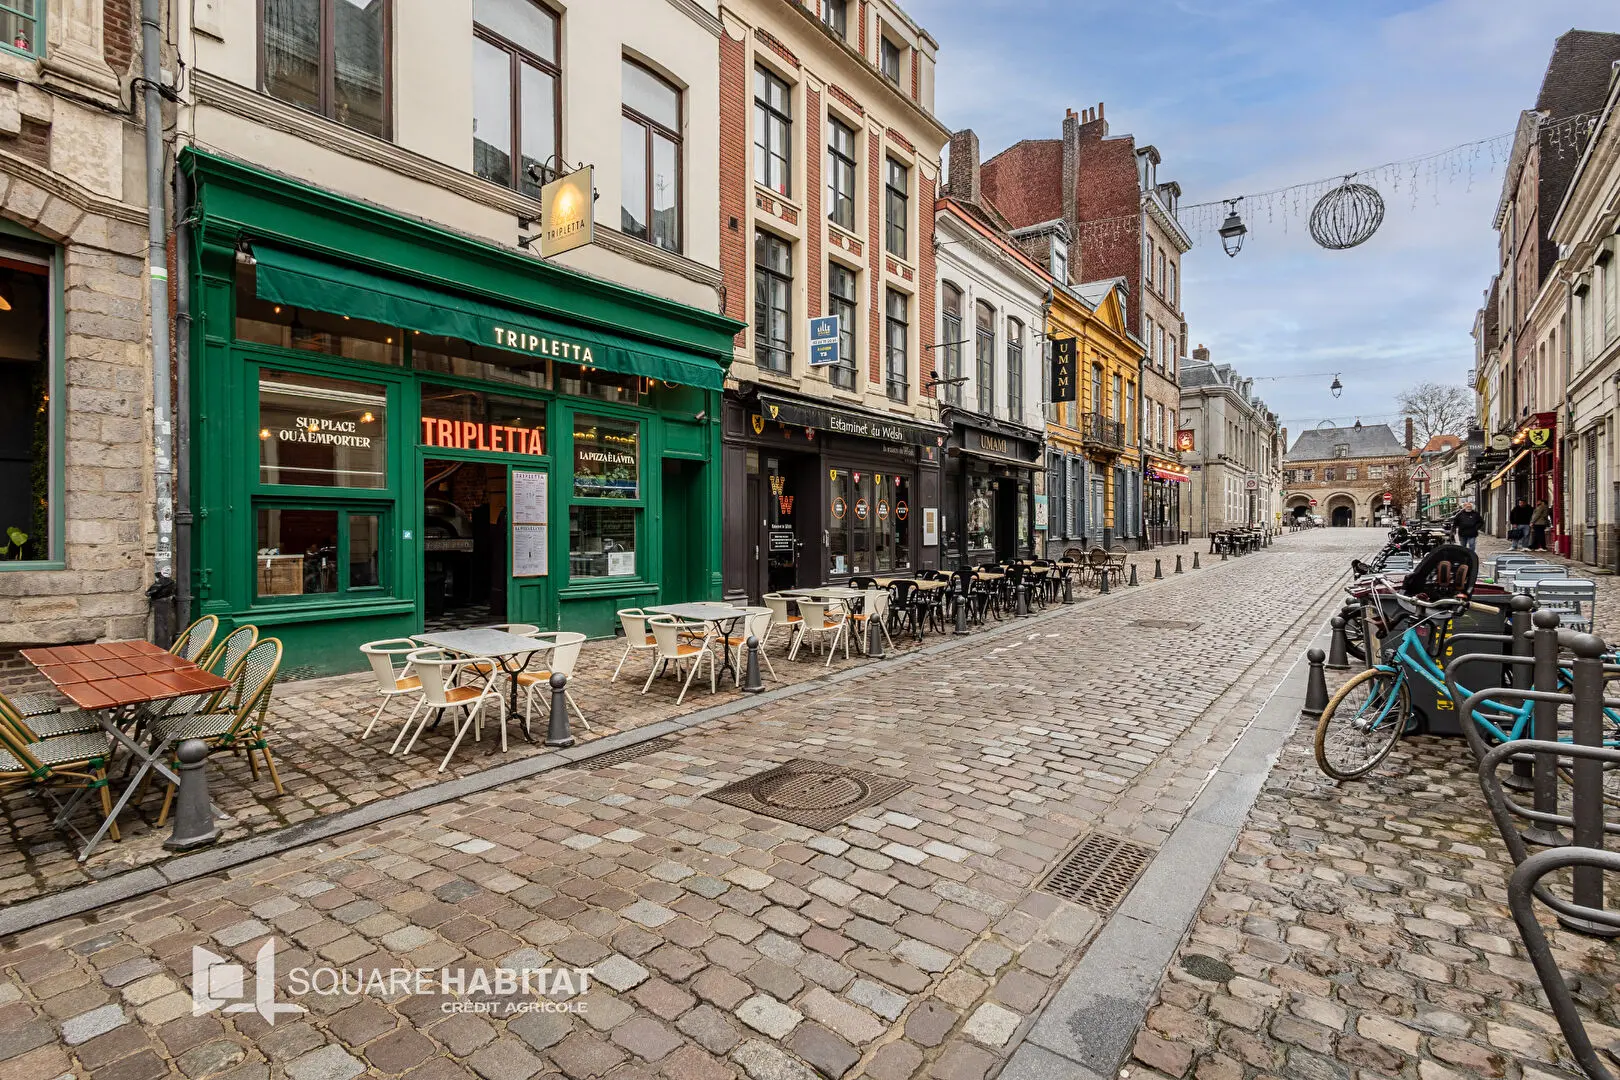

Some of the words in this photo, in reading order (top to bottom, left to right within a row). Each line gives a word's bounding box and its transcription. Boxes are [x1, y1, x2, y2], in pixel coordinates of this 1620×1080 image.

[547, 219, 585, 241] TRIPLETTA
[494, 327, 594, 363] TRIPLETTA
[1058, 343, 1069, 398] UMAMI
[296, 416, 319, 430] SUR
[321, 419, 356, 433] PLACE
[830, 416, 868, 435] Estaminet
[871, 423, 881, 437] du
[882, 426, 903, 441] Welsh
[280, 430, 297, 442] OU
[298, 428, 307, 442] À
[308, 432, 370, 448] EMPORTER
[421, 416, 543, 456] TRIPLETTA
[980, 434, 1007, 454] UMAMI
[580, 451, 589, 461] LA
[589, 452, 607, 462] PIZZA
[621, 455, 635, 465] VITA
